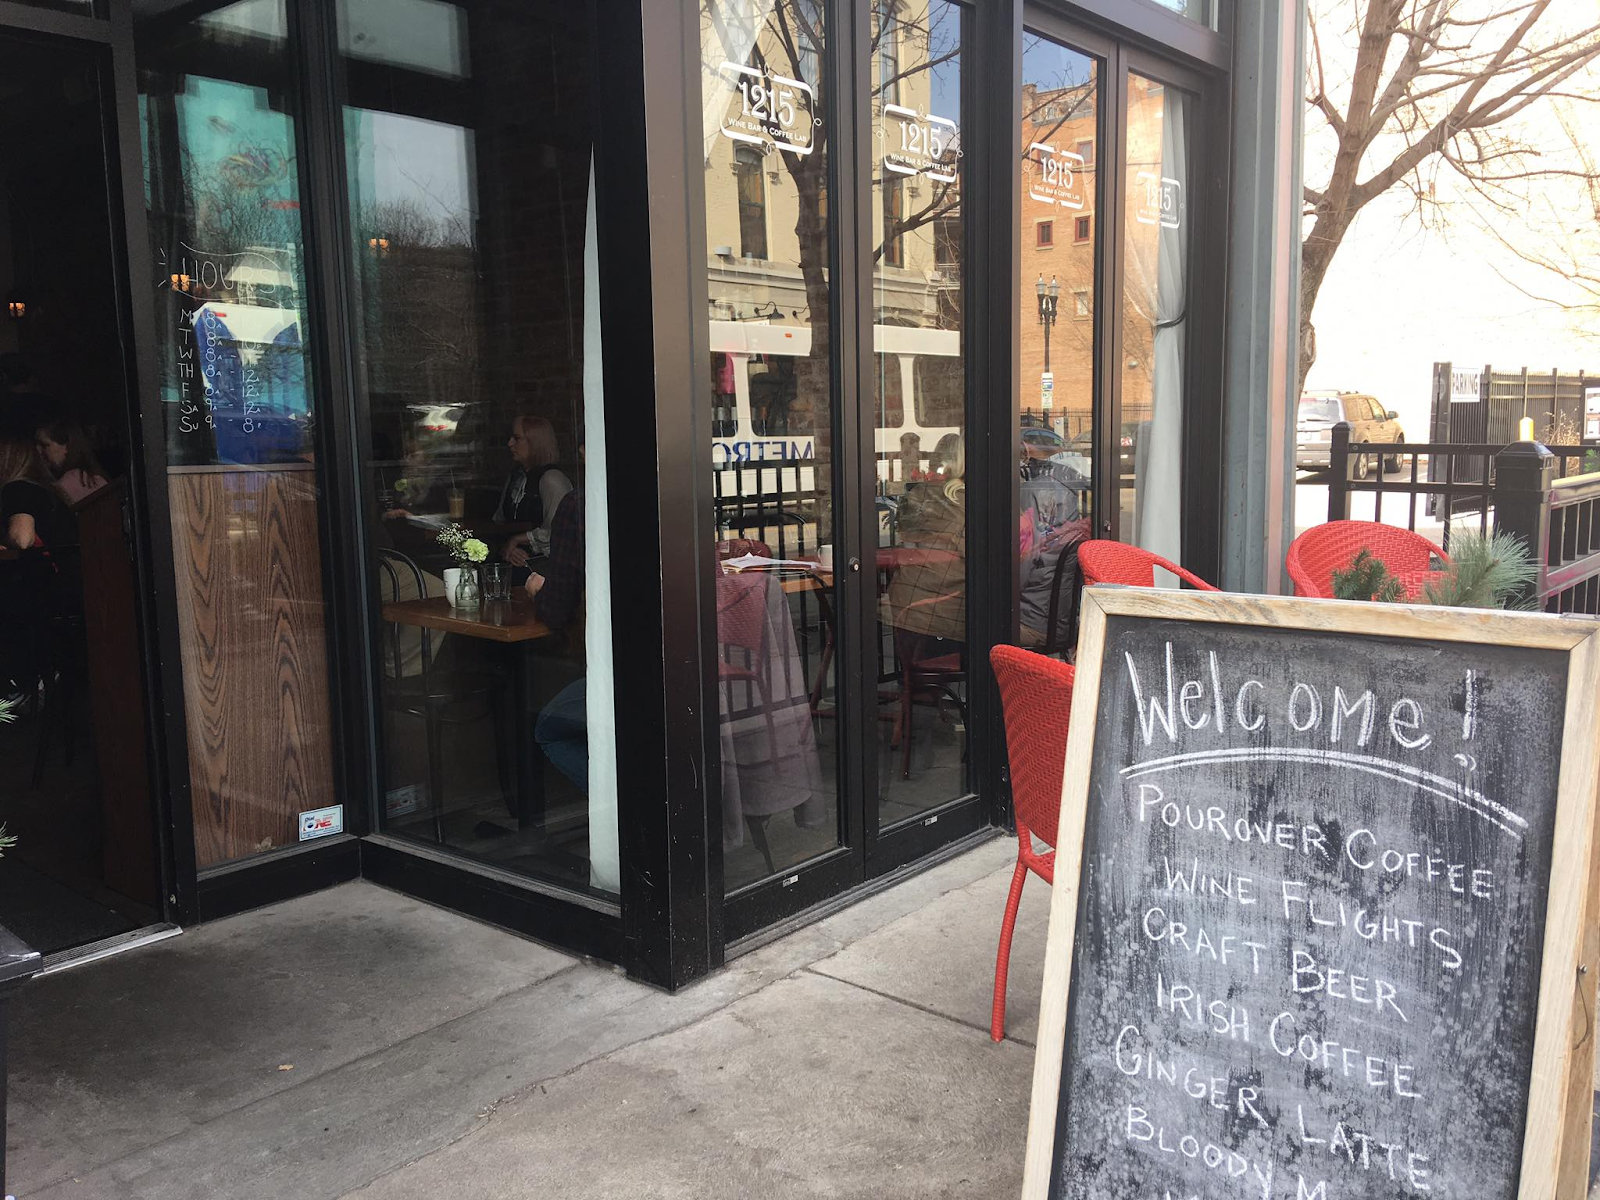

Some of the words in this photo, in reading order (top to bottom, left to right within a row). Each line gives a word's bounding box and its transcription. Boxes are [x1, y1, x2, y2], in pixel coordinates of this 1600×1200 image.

[738, 81, 796, 127] 1215
[727, 117, 746, 129] WINE
[748, 123, 761, 132] BAR
[762, 125, 768, 133] &
[769, 127, 793, 140] COFFEE
[794, 133, 807, 142] LAB
[899, 121, 942, 159] 1215
[1040, 156, 1073, 189] 1215
[1146, 182, 1171, 211] 1215
[181, 257, 277, 294] HOURS
[180, 308, 193, 324] M
[179, 328, 192, 344] T
[179, 346, 193, 359] W
[177, 362, 194, 378] TH
[1452, 373, 1478, 395] PARKING
[182, 382, 190, 398] F
[1138, 783, 1332, 861] POUROVER
[1346, 828, 1495, 900] COFFEE
[1164, 856, 1255, 904] WINE
[1281, 881, 1462, 970] FLIGHTS
[1144, 907, 1267, 973] CRAFT
[1292, 950, 1408, 1022] BEER
[1157, 973, 1251, 1041] IRISH
[1269, 1012, 1422, 1098] COFFEE
[1115, 1025, 1270, 1128] GINGER
[1297, 1104, 1432, 1190] LATTE
[1127, 1104, 1274, 1200] BLOODY
